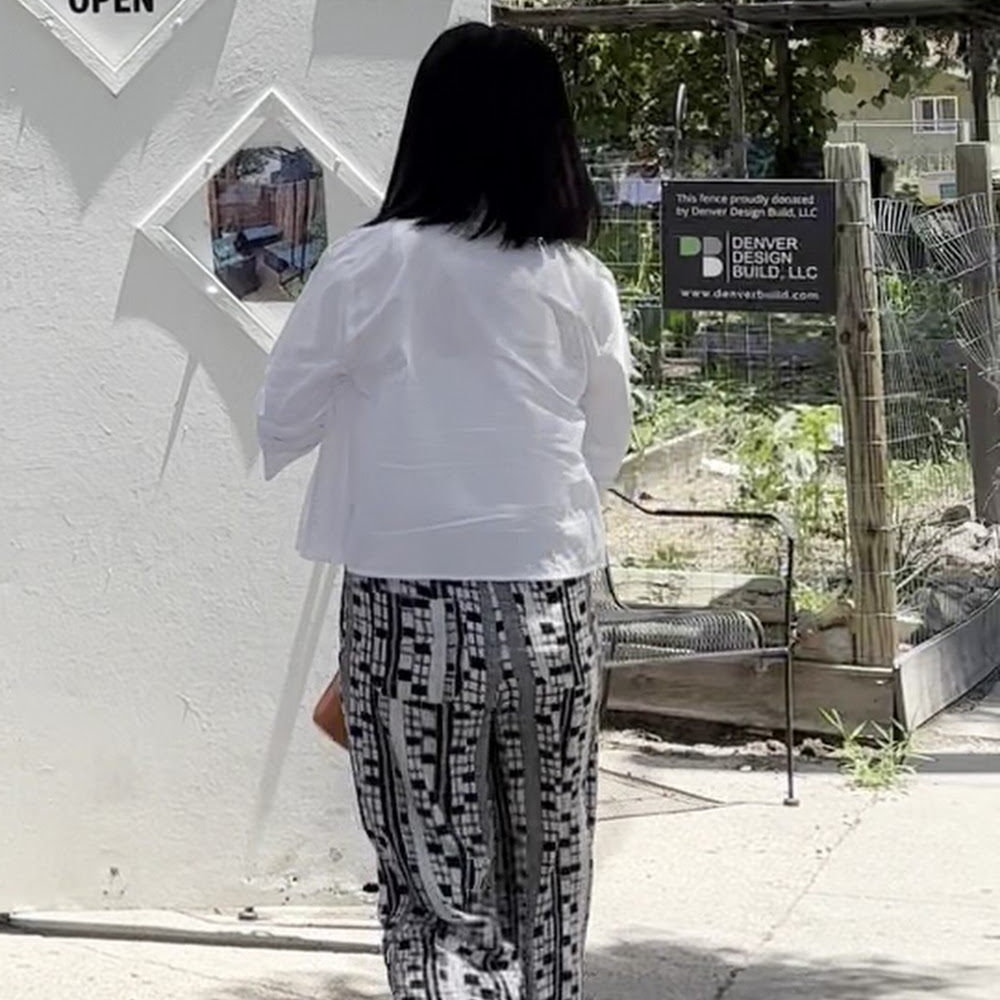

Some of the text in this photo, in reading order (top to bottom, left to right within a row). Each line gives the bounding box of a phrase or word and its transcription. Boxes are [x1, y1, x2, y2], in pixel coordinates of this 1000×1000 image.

[675, 193, 815, 207] This fence proudly donated
[675, 207, 689, 218] by
[691, 207, 728, 217] Denver
[729, 207, 766, 219] Design
[799, 208, 819, 218] LLC
[731, 236, 799, 250] DENVER
[731, 251, 793, 265] DESIGN
[732, 265, 819, 281] BUILD, LLC
[680, 287, 820, 301] www.denverbuild.com
